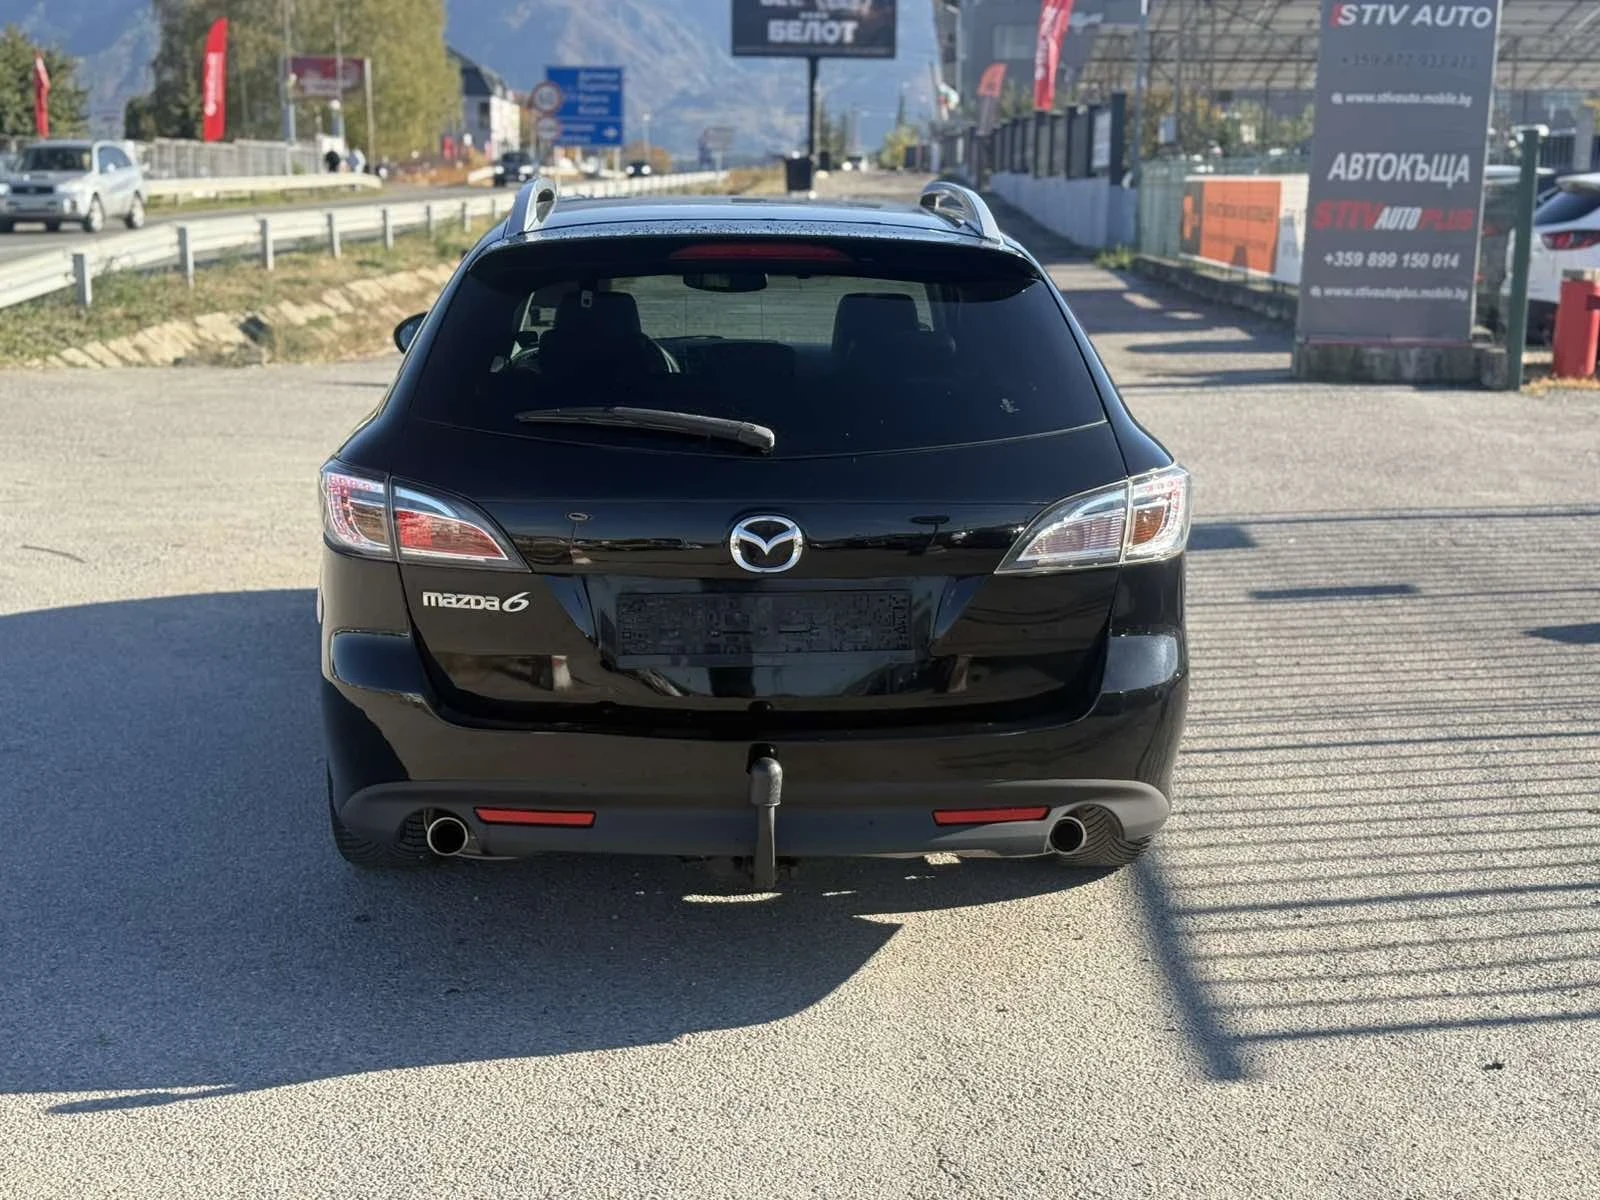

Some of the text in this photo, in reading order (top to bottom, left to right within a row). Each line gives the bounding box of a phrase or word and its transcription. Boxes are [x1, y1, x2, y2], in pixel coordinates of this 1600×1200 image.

[1411, 6, 1493, 29] AUTO
[767, 19, 858, 44] БЕЛОТ
[1327, 151, 1471, 189] АВТОКЪЩА
[1324, 251, 1460, 268] +359 899 150 014
